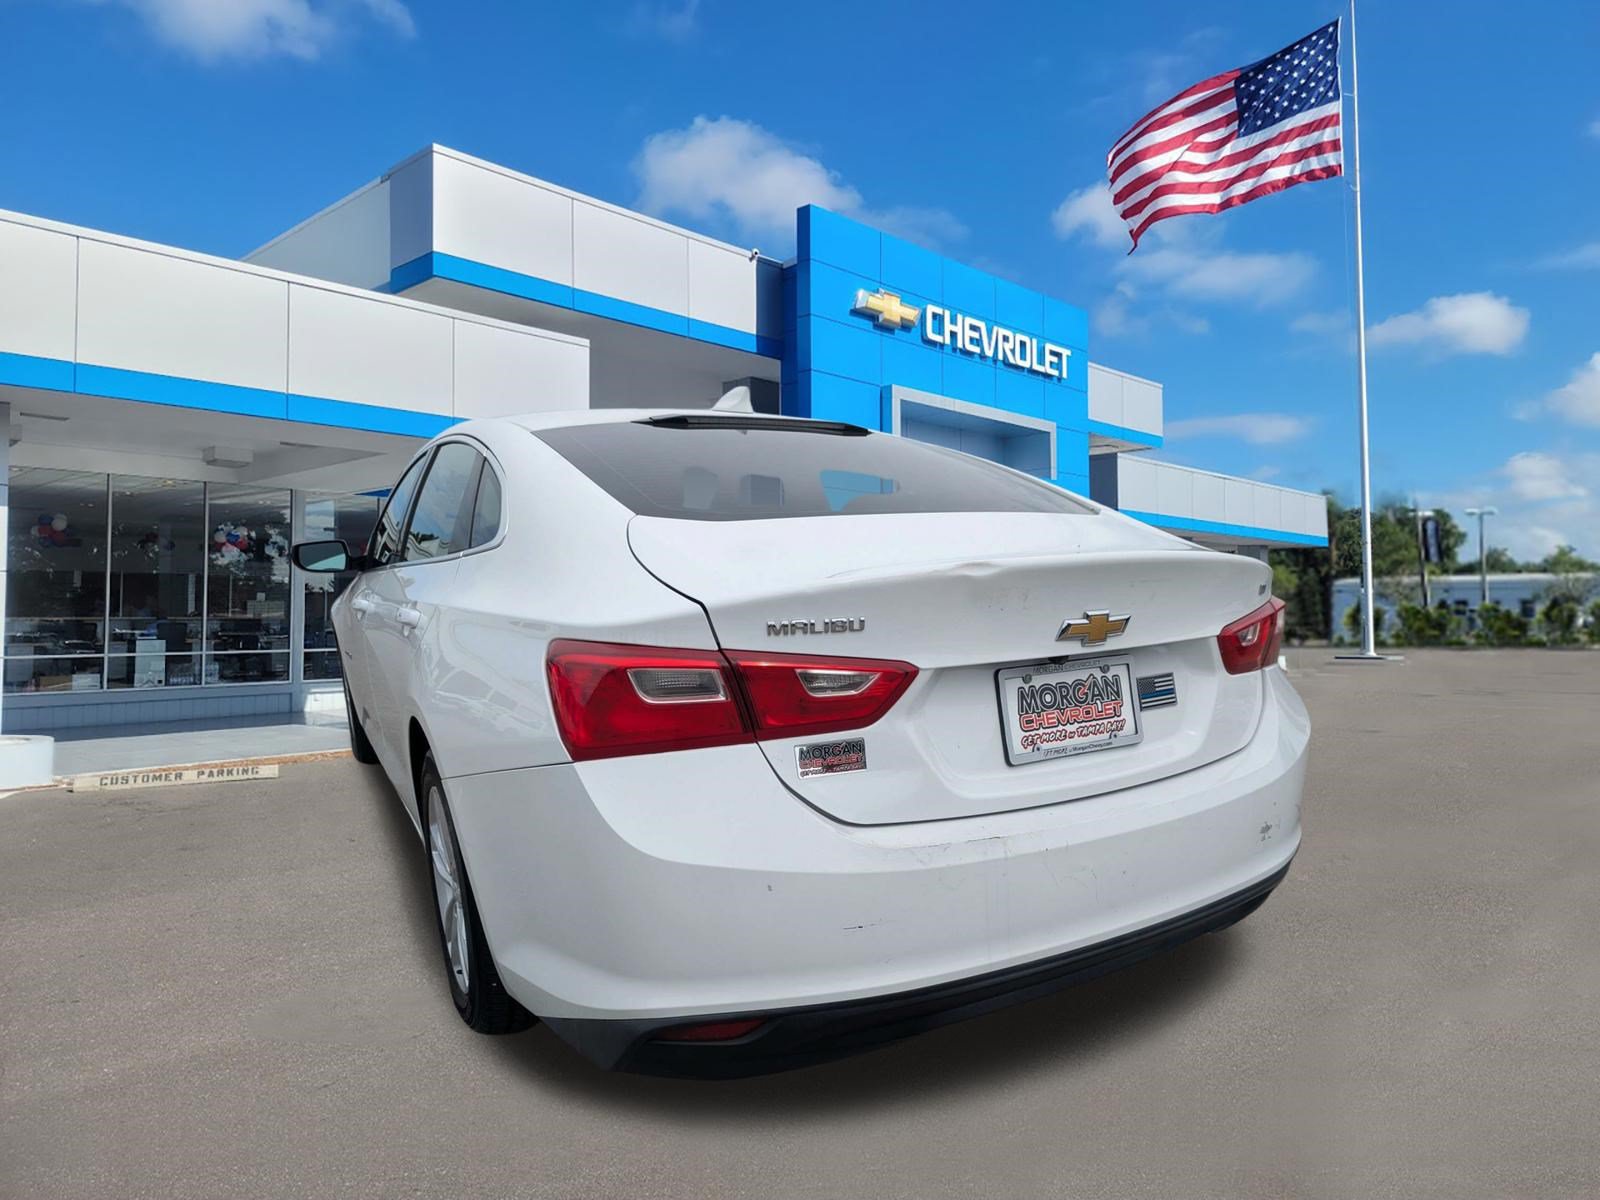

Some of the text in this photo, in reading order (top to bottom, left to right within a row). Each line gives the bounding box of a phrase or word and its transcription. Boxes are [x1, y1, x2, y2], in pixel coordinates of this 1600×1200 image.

[923, 304, 1071, 379] CHEVROLET
[767, 617, 865, 636] MALIBU
[1018, 674, 1122, 714] MORGAN
[1020, 700, 1123, 732] CHEVROLET
[1021, 733, 1040, 749] GET
[1040, 729, 1067, 744] MORE
[1076, 722, 1105, 738] TAMPA
[799, 741, 863, 760] MORGAN
[100, 766, 259, 786] CUSTOMER PARKING
